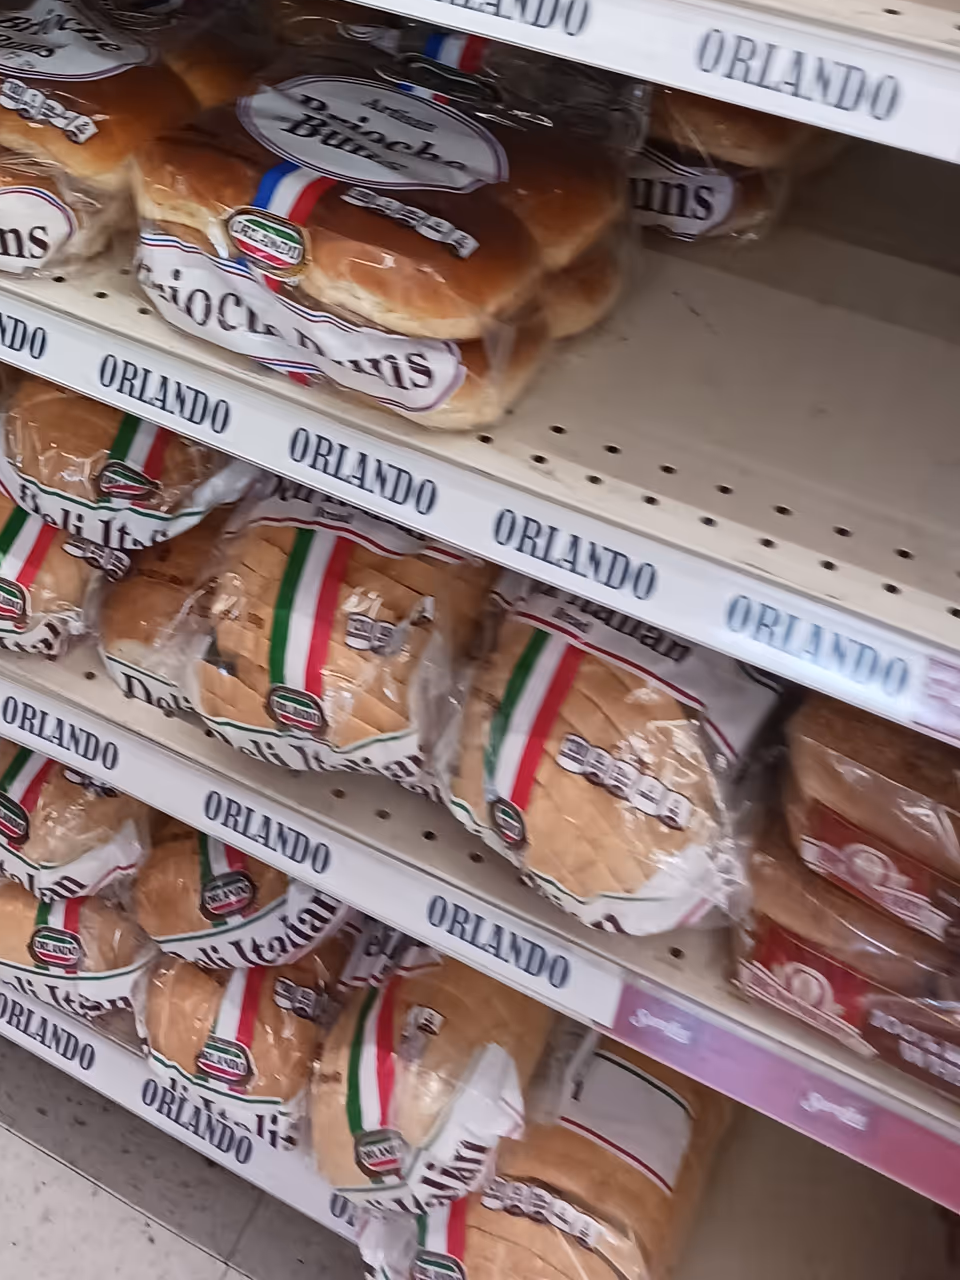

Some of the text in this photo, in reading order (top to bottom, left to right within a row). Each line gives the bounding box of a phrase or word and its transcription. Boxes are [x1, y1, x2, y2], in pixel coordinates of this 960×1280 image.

[361, 98, 438, 132] Artisan
[696, 28, 902, 122] ORLANDO
[633, 177, 716, 224] uns
[99, 353, 230, 434] ORLANDO
[289, 427, 438, 516] ORLANDO
[493, 508, 658, 600] ORLANDO
[725, 594, 910, 698] ORLANDO
[1, 696, 119, 771] ORLANDO
[204, 789, 331, 874] ORLANDO
[205, 884, 252, 905] ORLANDO
[427, 894, 570, 989] ORLANDO
[141, 1077, 253, 1165] ORLANDO
